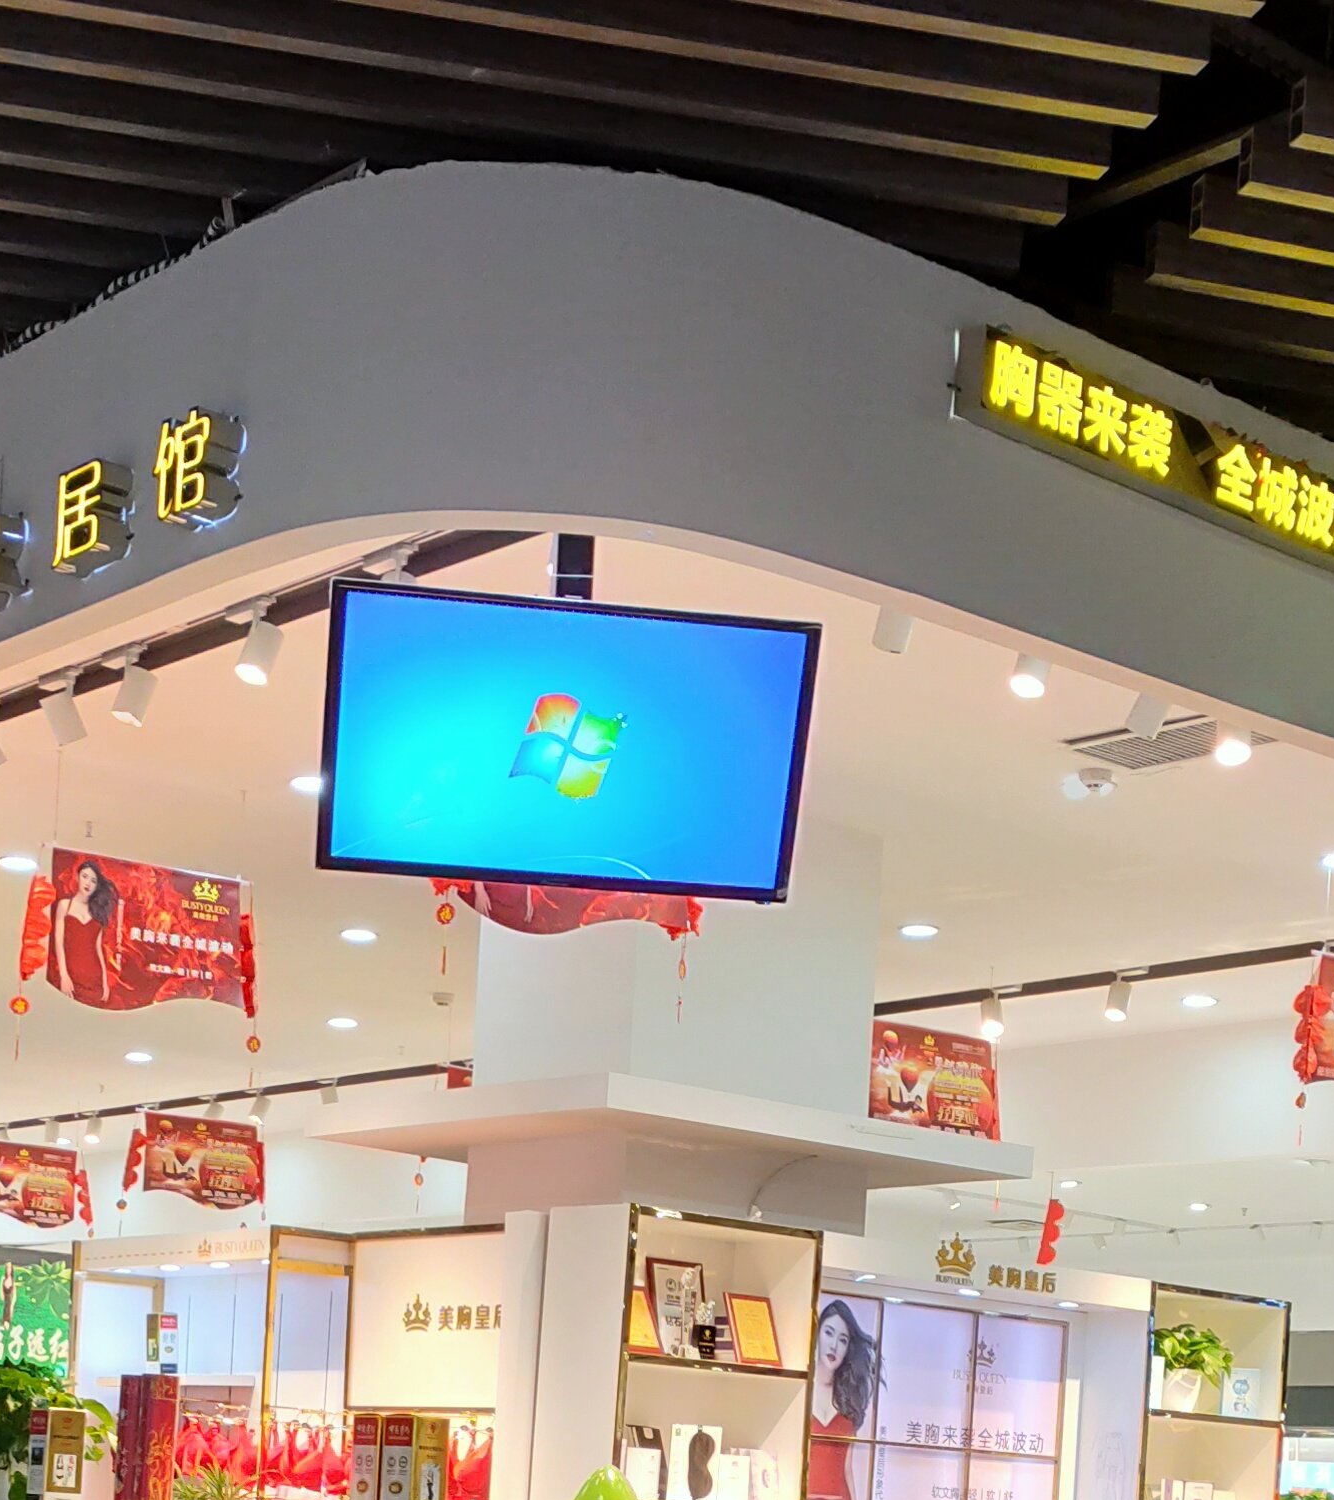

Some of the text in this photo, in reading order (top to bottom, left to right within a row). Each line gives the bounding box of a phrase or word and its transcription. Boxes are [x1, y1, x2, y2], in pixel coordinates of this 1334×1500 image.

[988, 340, 1172, 477] 胸器来袭
[987, 1264, 1057, 1294] 美胸皇后
[906, 1420, 1045, 1454] 美胸来袭全城波动
